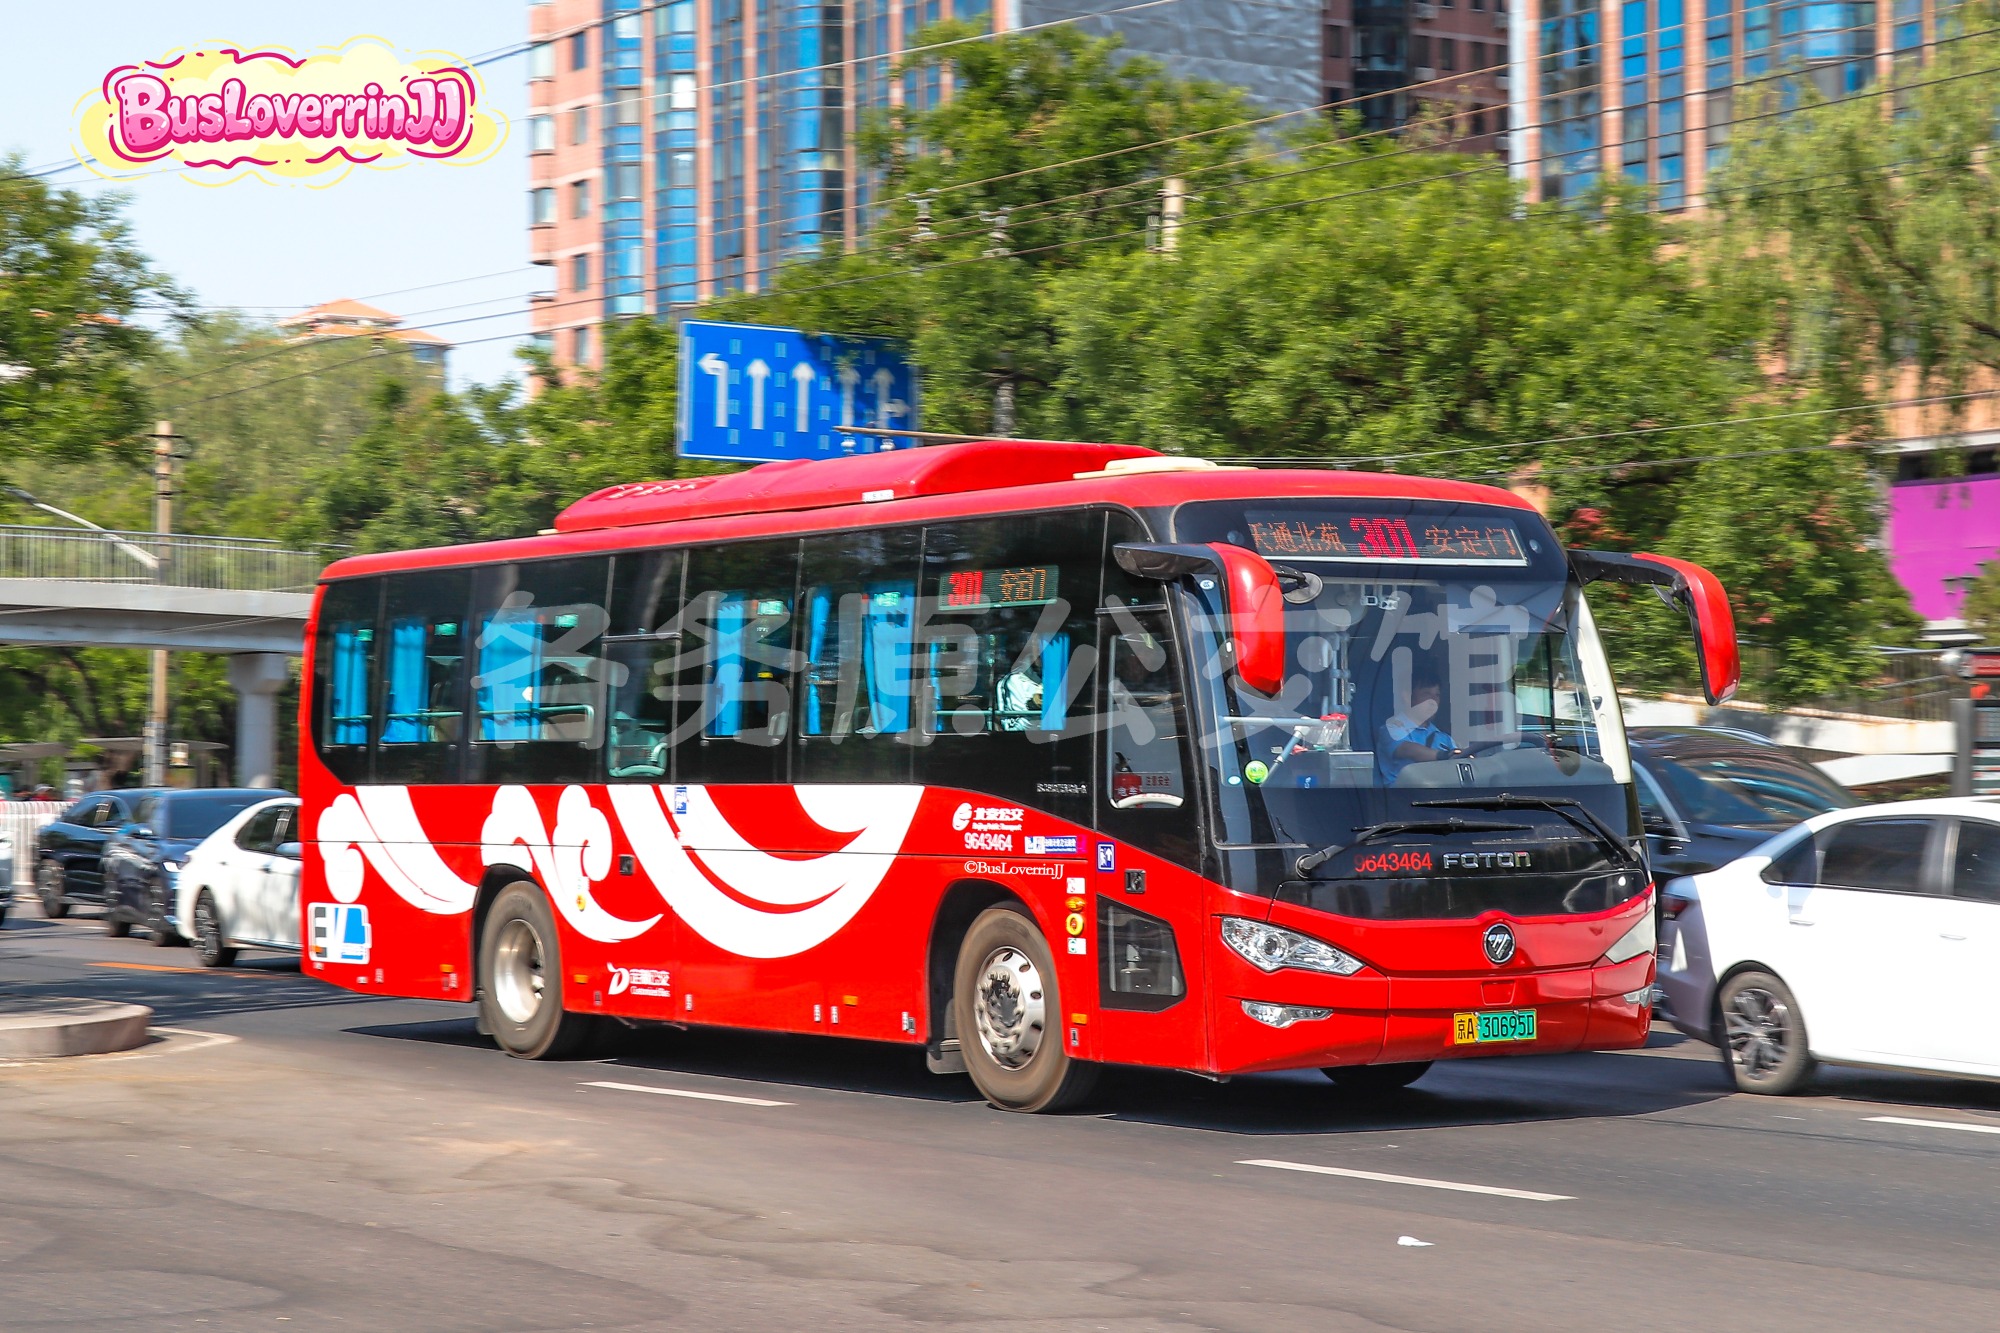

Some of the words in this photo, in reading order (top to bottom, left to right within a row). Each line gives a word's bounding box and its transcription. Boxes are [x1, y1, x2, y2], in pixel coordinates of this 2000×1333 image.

[1349, 517, 1421, 559] 301
[1425, 526, 1517, 556] 安定门
[946, 569, 983, 606] 301
[998, 567, 1046, 602] 安定门
[964, 832, 1013, 852] 9643464
[1354, 852, 1433, 873] 9643464
